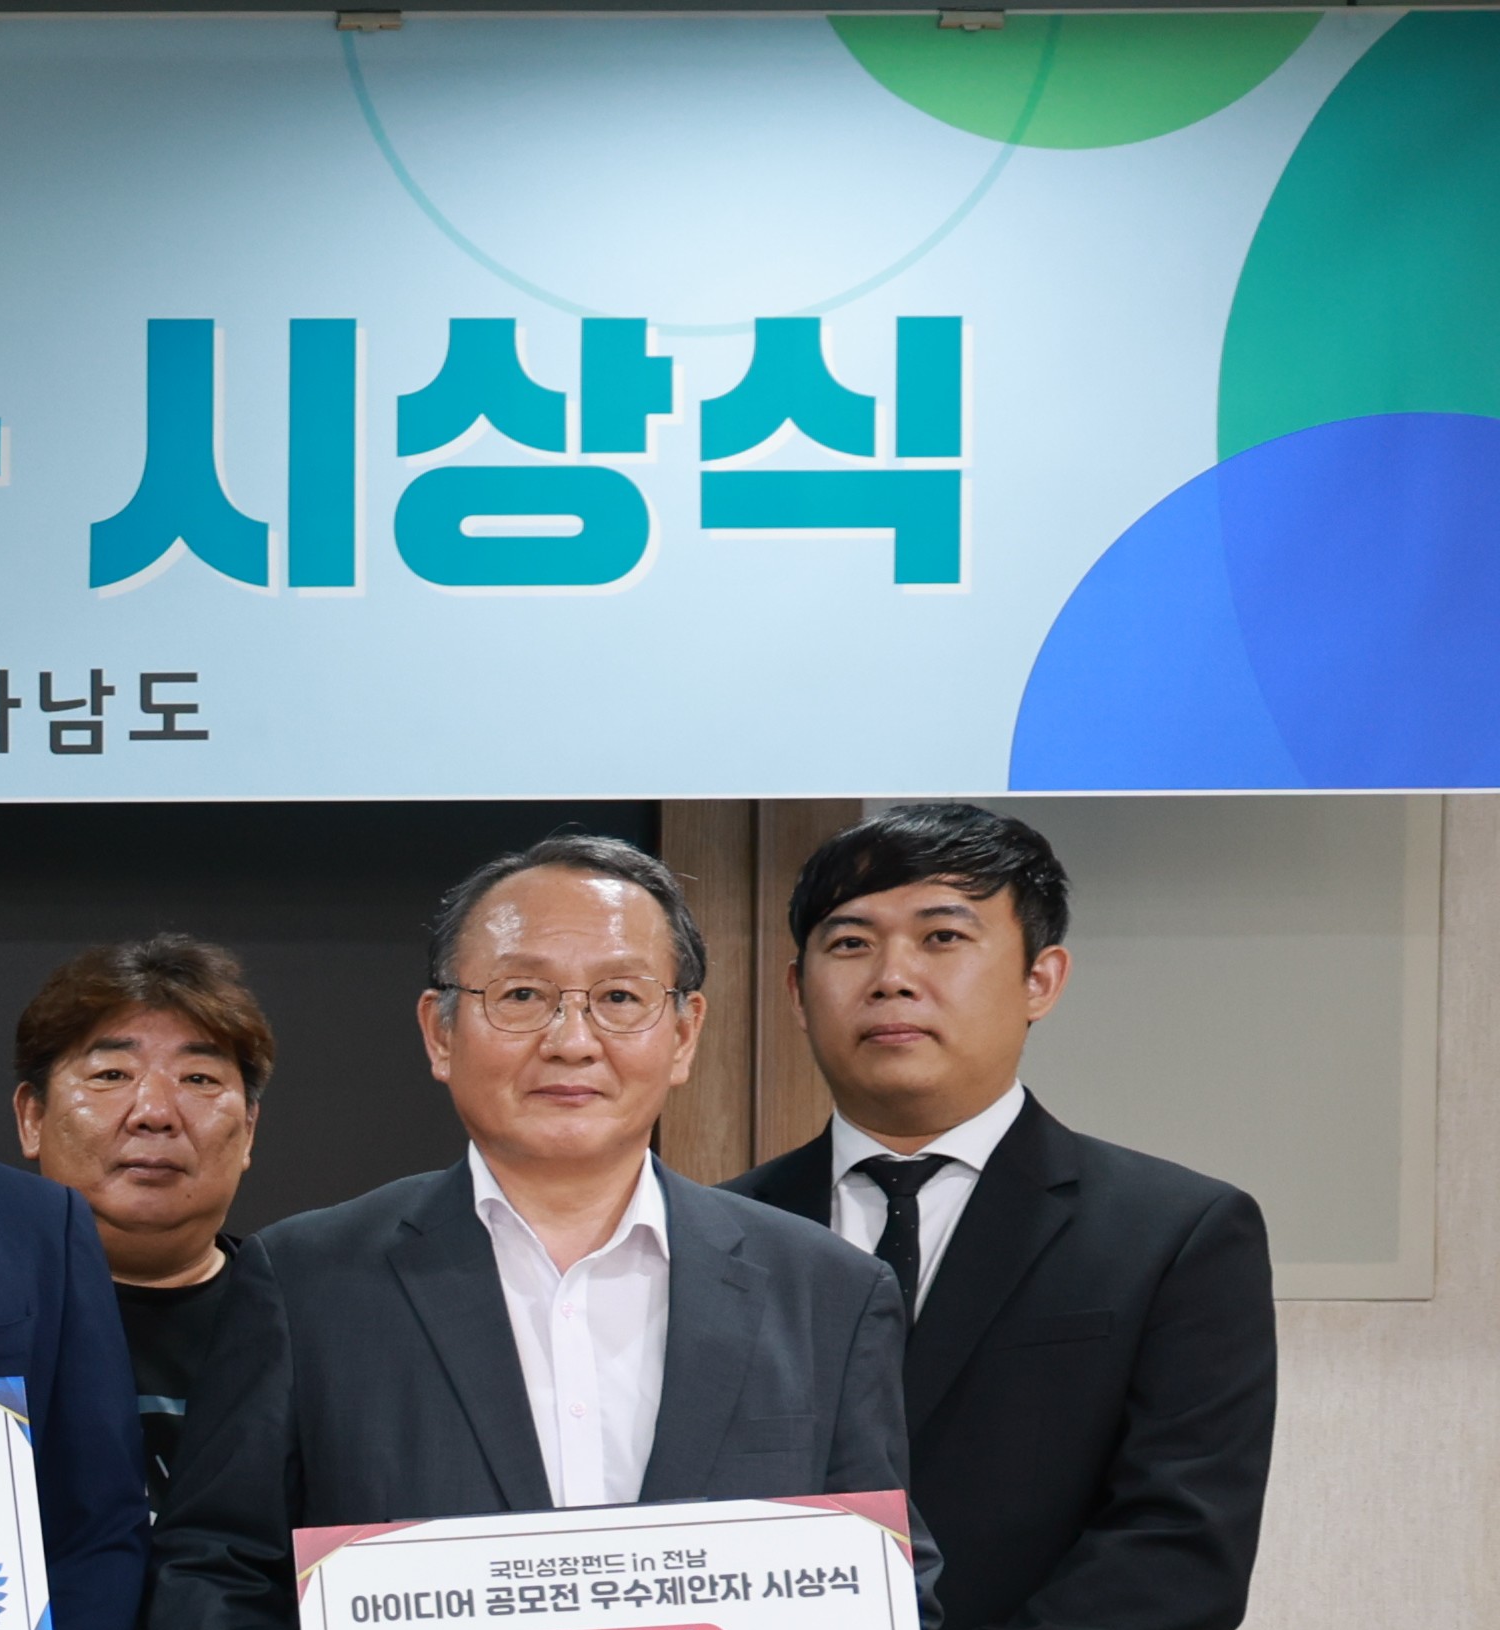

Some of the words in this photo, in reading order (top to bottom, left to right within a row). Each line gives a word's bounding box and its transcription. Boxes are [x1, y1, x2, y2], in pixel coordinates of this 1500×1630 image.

[90, 317, 961, 588] 시상식
[490, 1554, 625, 1579] 국민성장펀드
[632, 1553, 655, 1572] in
[663, 1549, 706, 1569] 전남
[352, 1589, 475, 1622] 아이디어
[486, 1583, 580, 1615] 공모전
[591, 1572, 752, 1609] 우수제안자
[763, 1566, 859, 1598] 시상식
